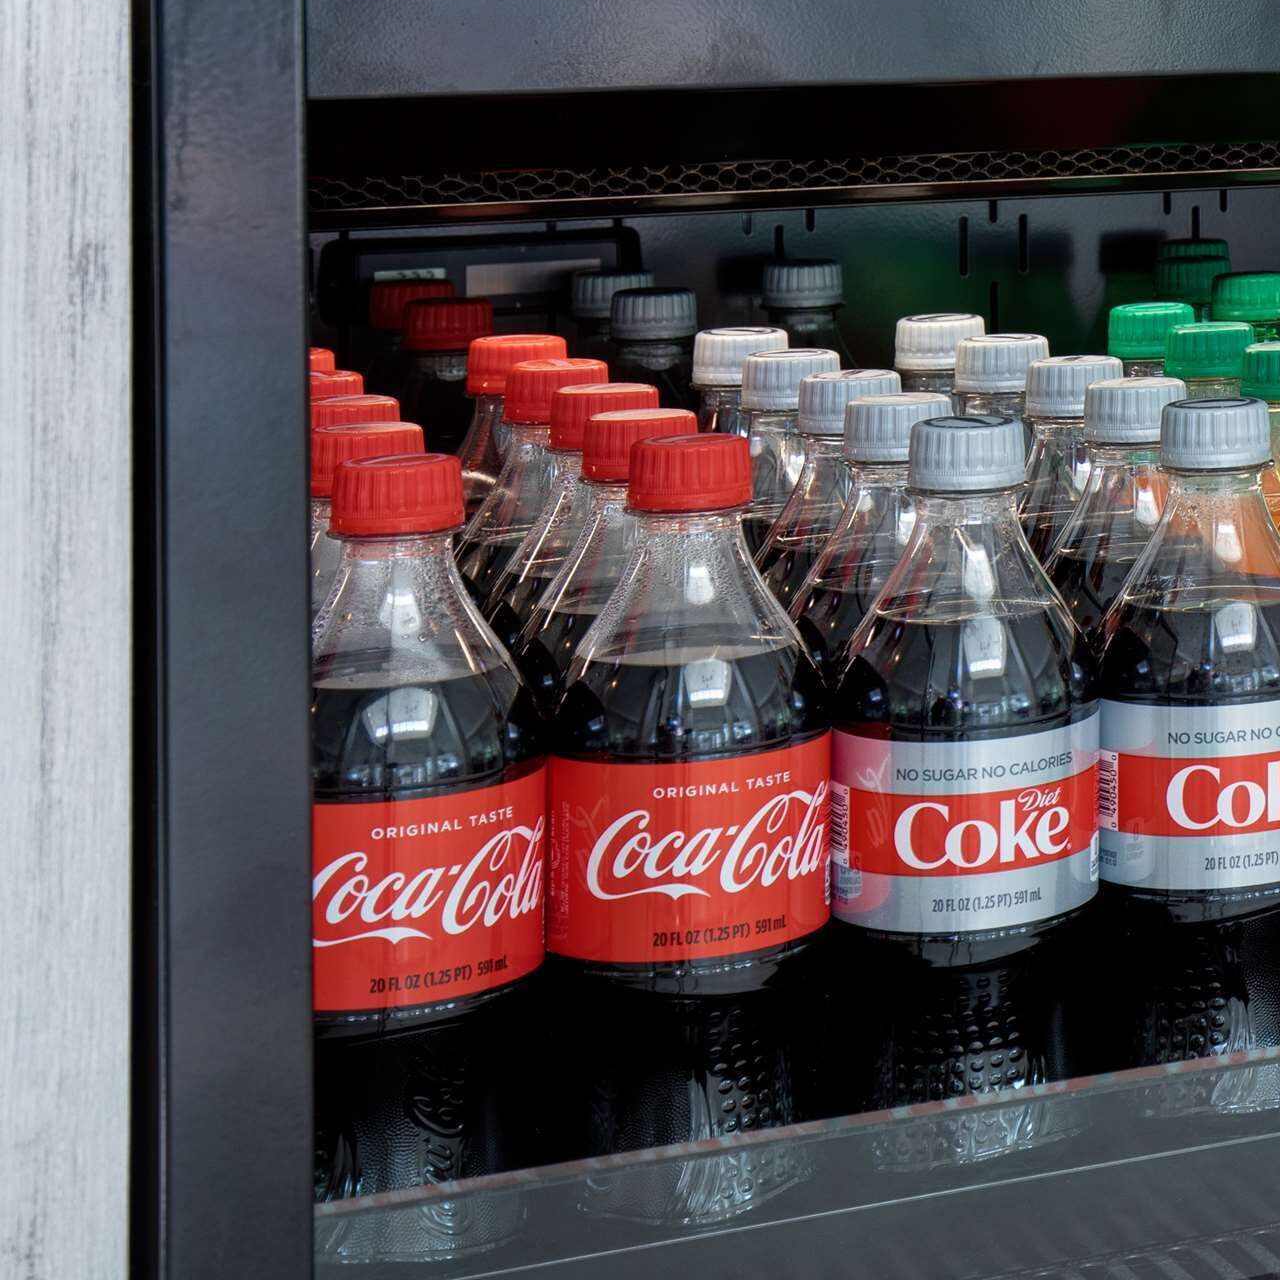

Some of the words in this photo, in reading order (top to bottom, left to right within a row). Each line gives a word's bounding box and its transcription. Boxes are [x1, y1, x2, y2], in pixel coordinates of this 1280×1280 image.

[1168, 730, 1191, 745] NO
[1194, 728, 1247, 745] SUGAR
[1251, 725, 1273, 740] NO
[896, 767, 919, 782] NO
[922, 766, 977, 782] SUGAR
[981, 763, 1005, 779] NO
[1007, 750, 1073, 778] CALORIES
[652, 780, 739, 800] ORIGINAL
[745, 771, 791, 787] TASTE
[1018, 786, 1062, 812] Diet
[371, 816, 463, 841] ORIGINAL
[469, 806, 514, 828] TASTE
[894, 799, 1071, 871] Coke
[586, 780, 827, 901] Coca-Cola
[1204, 855, 1216, 871] 20
[1218, 854, 1228, 870] FL
[1229, 853, 1241, 870] OZ
[1243, 851, 1263, 871] (1.25
[1265, 850, 1280, 868] PT)
[313, 817, 543, 948] Coca-Cola
[932, 897, 944, 913] 20
[946, 896, 958, 912] FL
[958, 895, 972, 911] OZ
[974, 893, 995, 912] (1.25
[996, 891, 1012, 910] PT)
[1014, 888, 1028, 905] 591
[1030, 886, 1042, 902] mL
[652, 930, 667, 947] 20
[670, 929, 684, 946] FL
[685, 928, 701, 945] OZ
[703, 925, 730, 944] (1.25
[732, 922, 751, 941] PT)
[755, 918, 772, 935] 591
[774, 915, 787, 931] mL
[370, 977, 385, 994] 20
[388, 975, 402, 992] FL
[405, 972, 421, 990] OZ
[424, 969, 452, 989] (1.25
[454, 966, 473, 986] PT)
[477, 960, 493, 978] 591
[495, 956, 508, 972] mL
